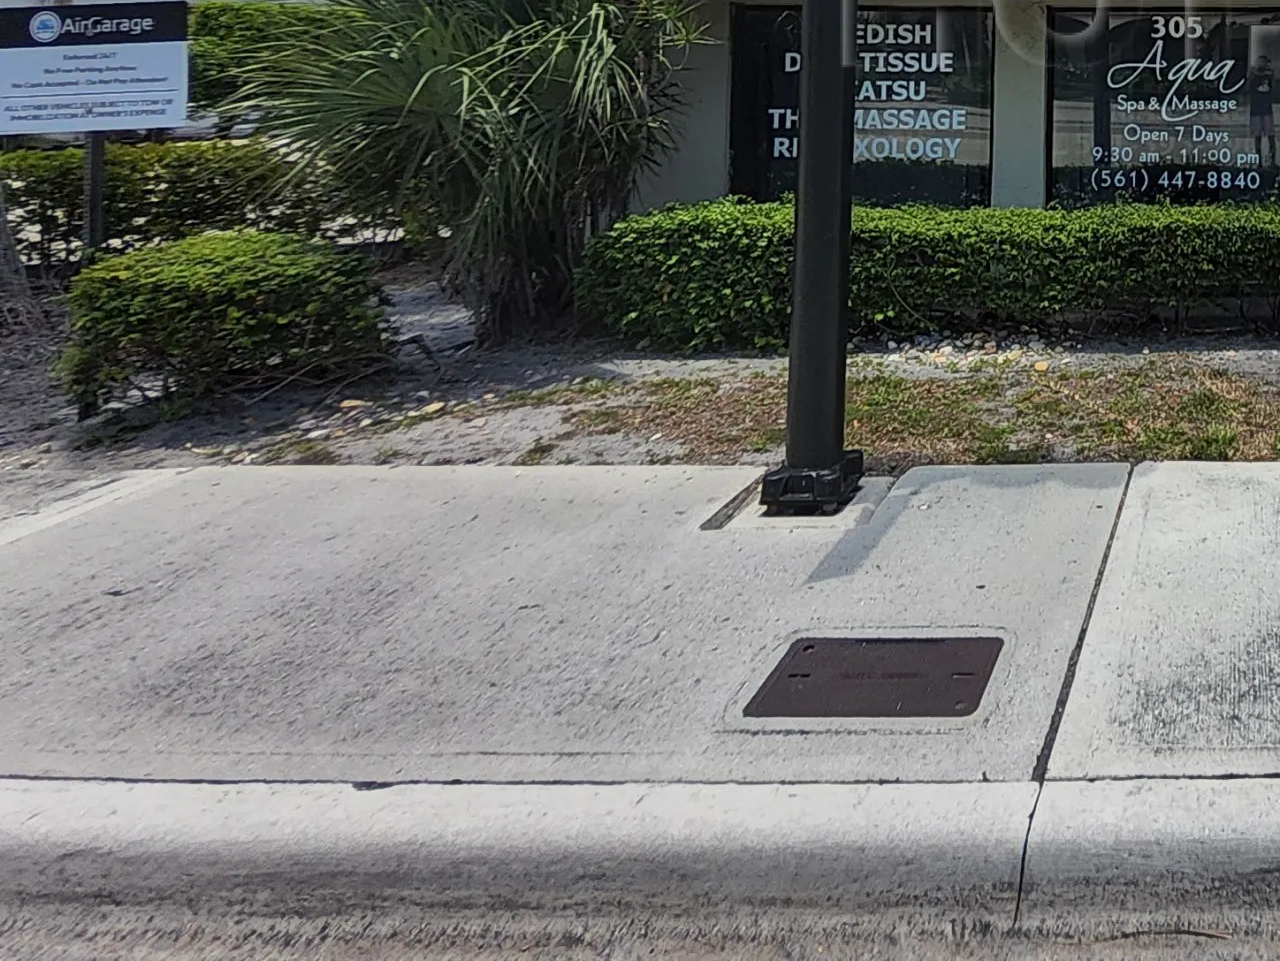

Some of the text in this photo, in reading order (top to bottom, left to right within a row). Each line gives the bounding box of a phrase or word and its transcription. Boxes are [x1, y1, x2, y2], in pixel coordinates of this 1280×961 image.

[60, 16, 155, 35] AirGarage
[856, 24, 932, 45] EDISH
[1151, 16, 1203, 38] 305
[859, 52, 953, 72] TISSUE
[1107, 39, 1245, 121] Aqua
[1117, 94, 1237, 113] Spa & Massage
[1124, 124, 1229, 145] Open 7 Days
[1092, 147, 1133, 162] 9:30
[1139, 151, 1160, 162] am
[1180, 148, 1231, 163] 11:00
[1237, 152, 1260, 166] pm
[1091, 169, 1261, 191] (561) 447-8840
